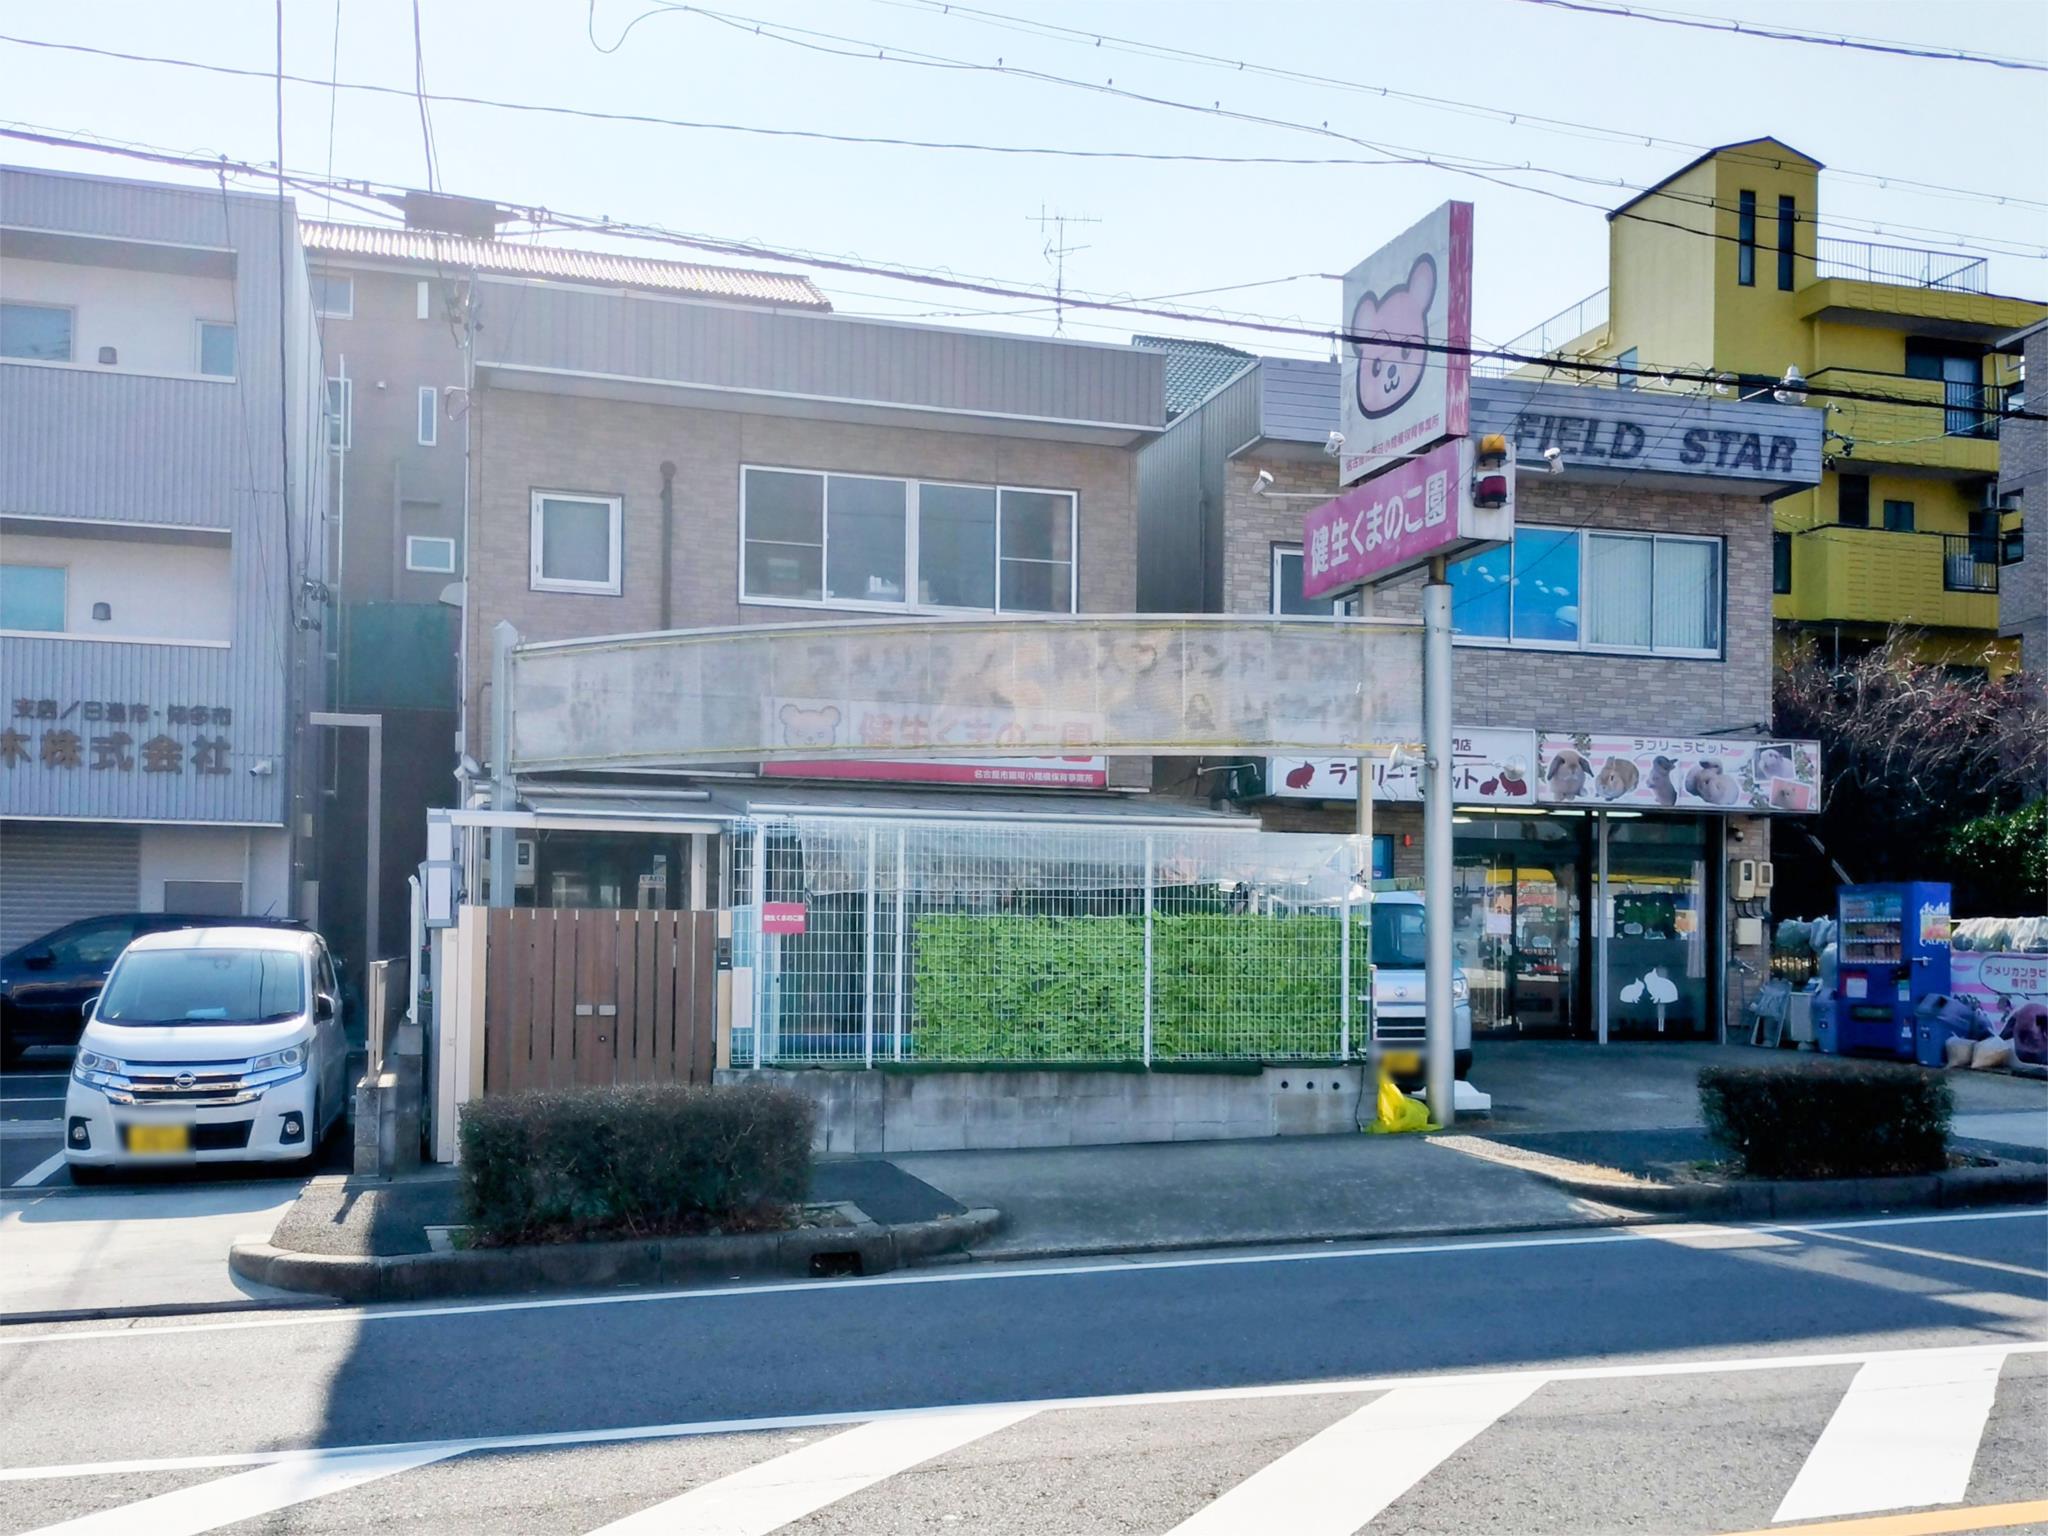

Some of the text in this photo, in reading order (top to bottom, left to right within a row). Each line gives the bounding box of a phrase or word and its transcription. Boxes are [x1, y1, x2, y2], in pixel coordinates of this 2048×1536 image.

[1514, 412, 1797, 473] FIELD STAR
[1311, 469, 1448, 577] 健生くまのこ園
